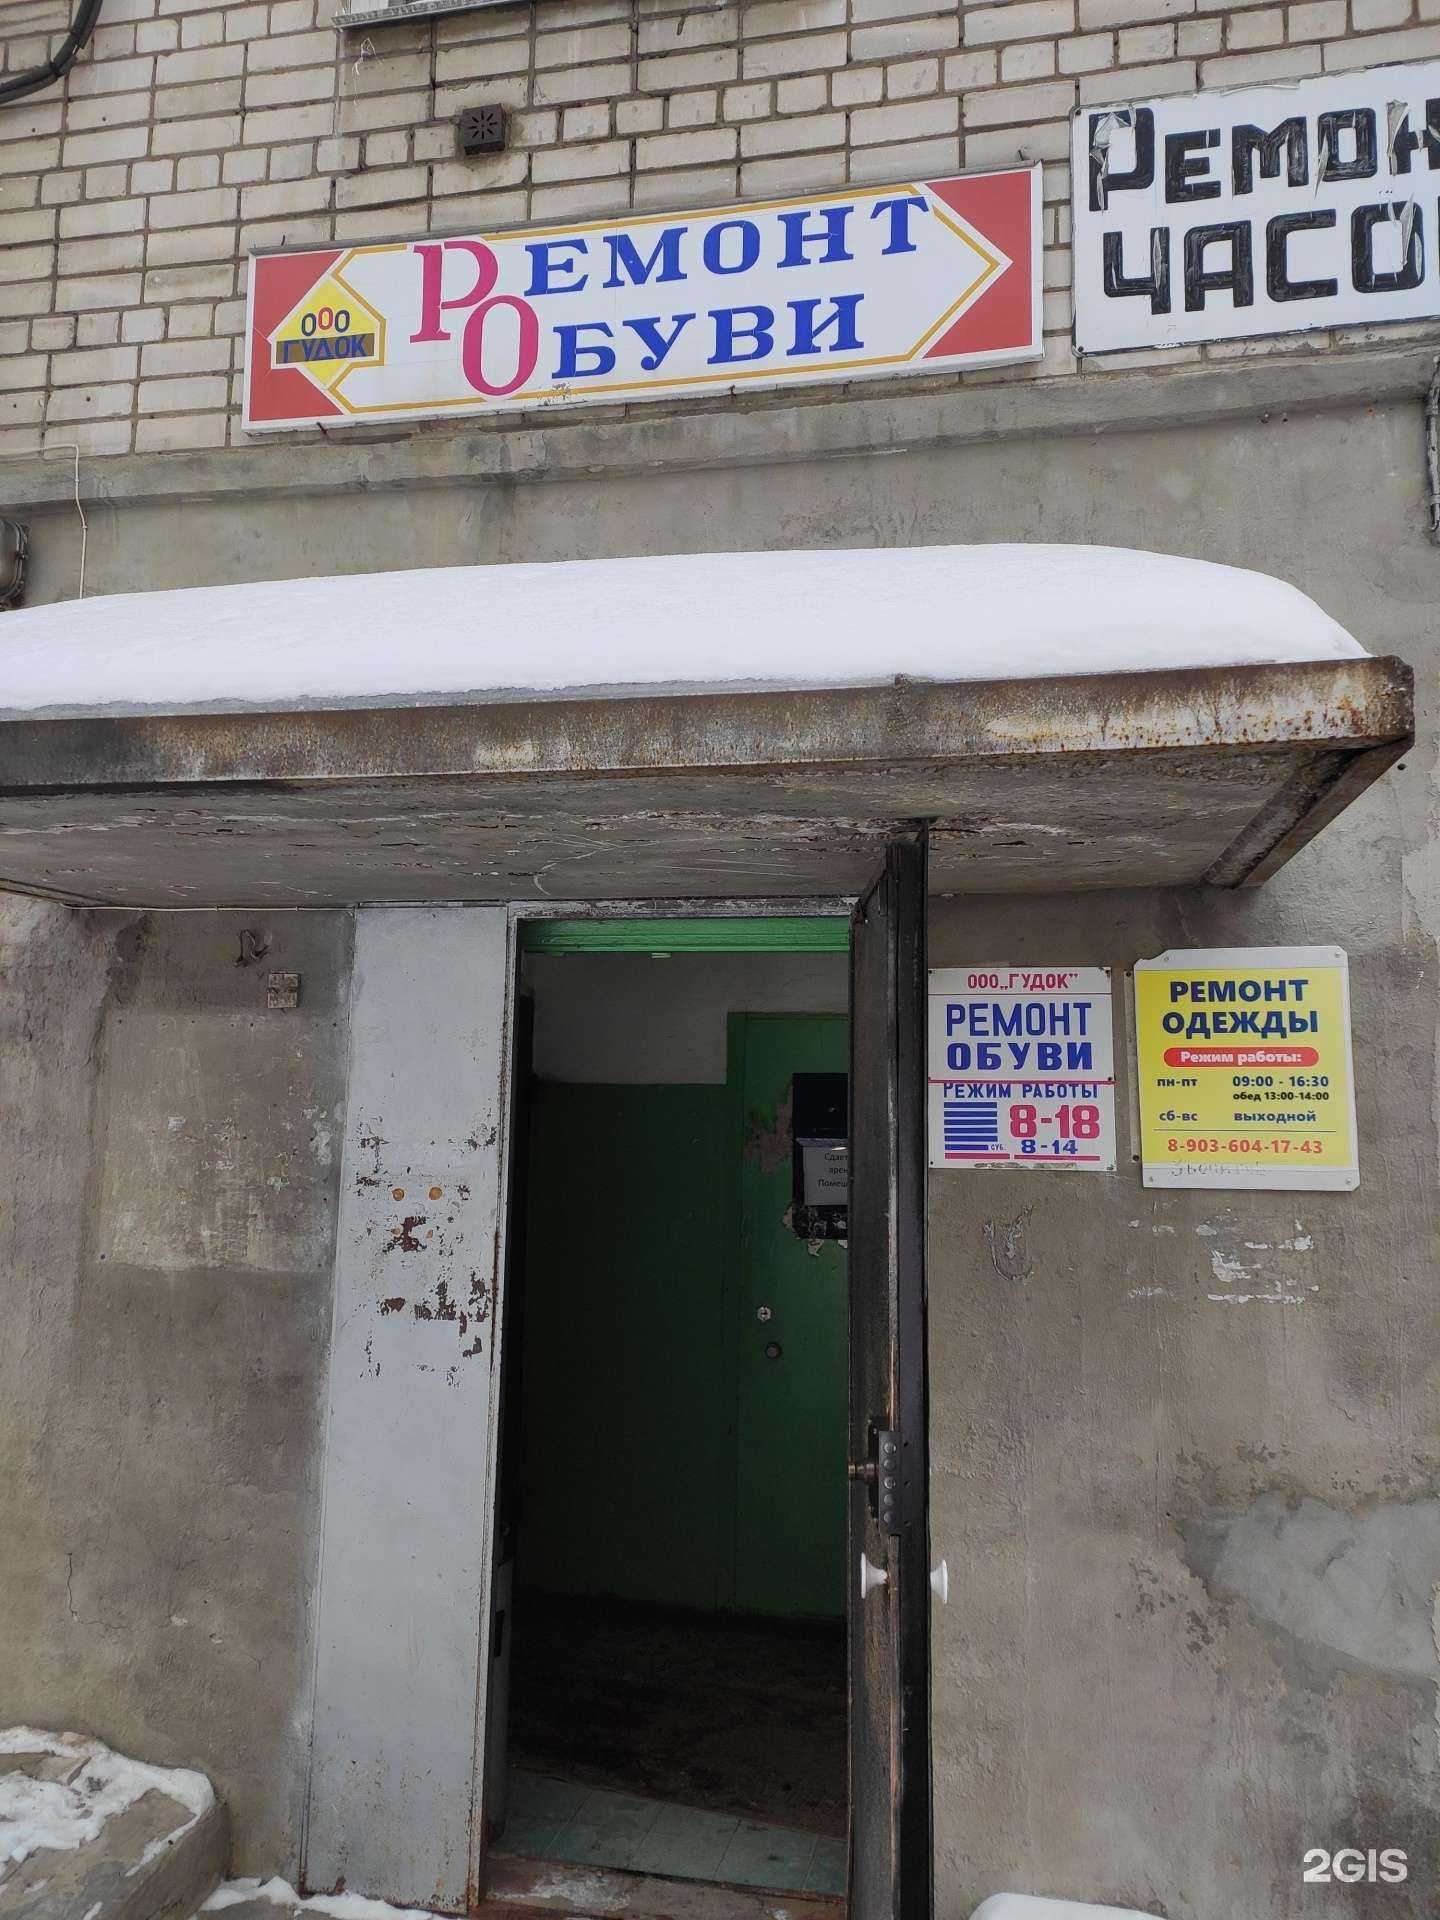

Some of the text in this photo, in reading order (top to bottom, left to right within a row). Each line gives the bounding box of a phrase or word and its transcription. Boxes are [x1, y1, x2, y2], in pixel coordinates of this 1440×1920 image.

[1103, 197, 1440, 315] ЧАСО
[282, 336, 368, 364] ГУДОК
[462, 293, 865, 396] ОБУВИ
[1170, 979, 1308, 1003] РЕМОНТ
[946, 1002, 1092, 1037] РЕМОНТ
[1162, 1011, 1319, 1039] ОДЕЖДЫ
[946, 1042, 1093, 1070] ОБУВИ
[1180, 1051, 1302, 1065] Режим работы:
[943, 1083, 1098, 1099] РЕЖИМ РАБОТЫ
[1157, 1077, 1198, 1087] пн-пт
[1232, 1075, 1274, 1087] 09:00
[1289, 1075, 1330, 1087] 16:30
[1232, 1091, 1330, 1102] обед 13:00-14:00
[1009, 1104, 1100, 1139] 8-18
[1159, 1111, 1317, 1123] сб-вс выходной
[1167, 1138, 1324, 1154] 8-903-604-17-43
